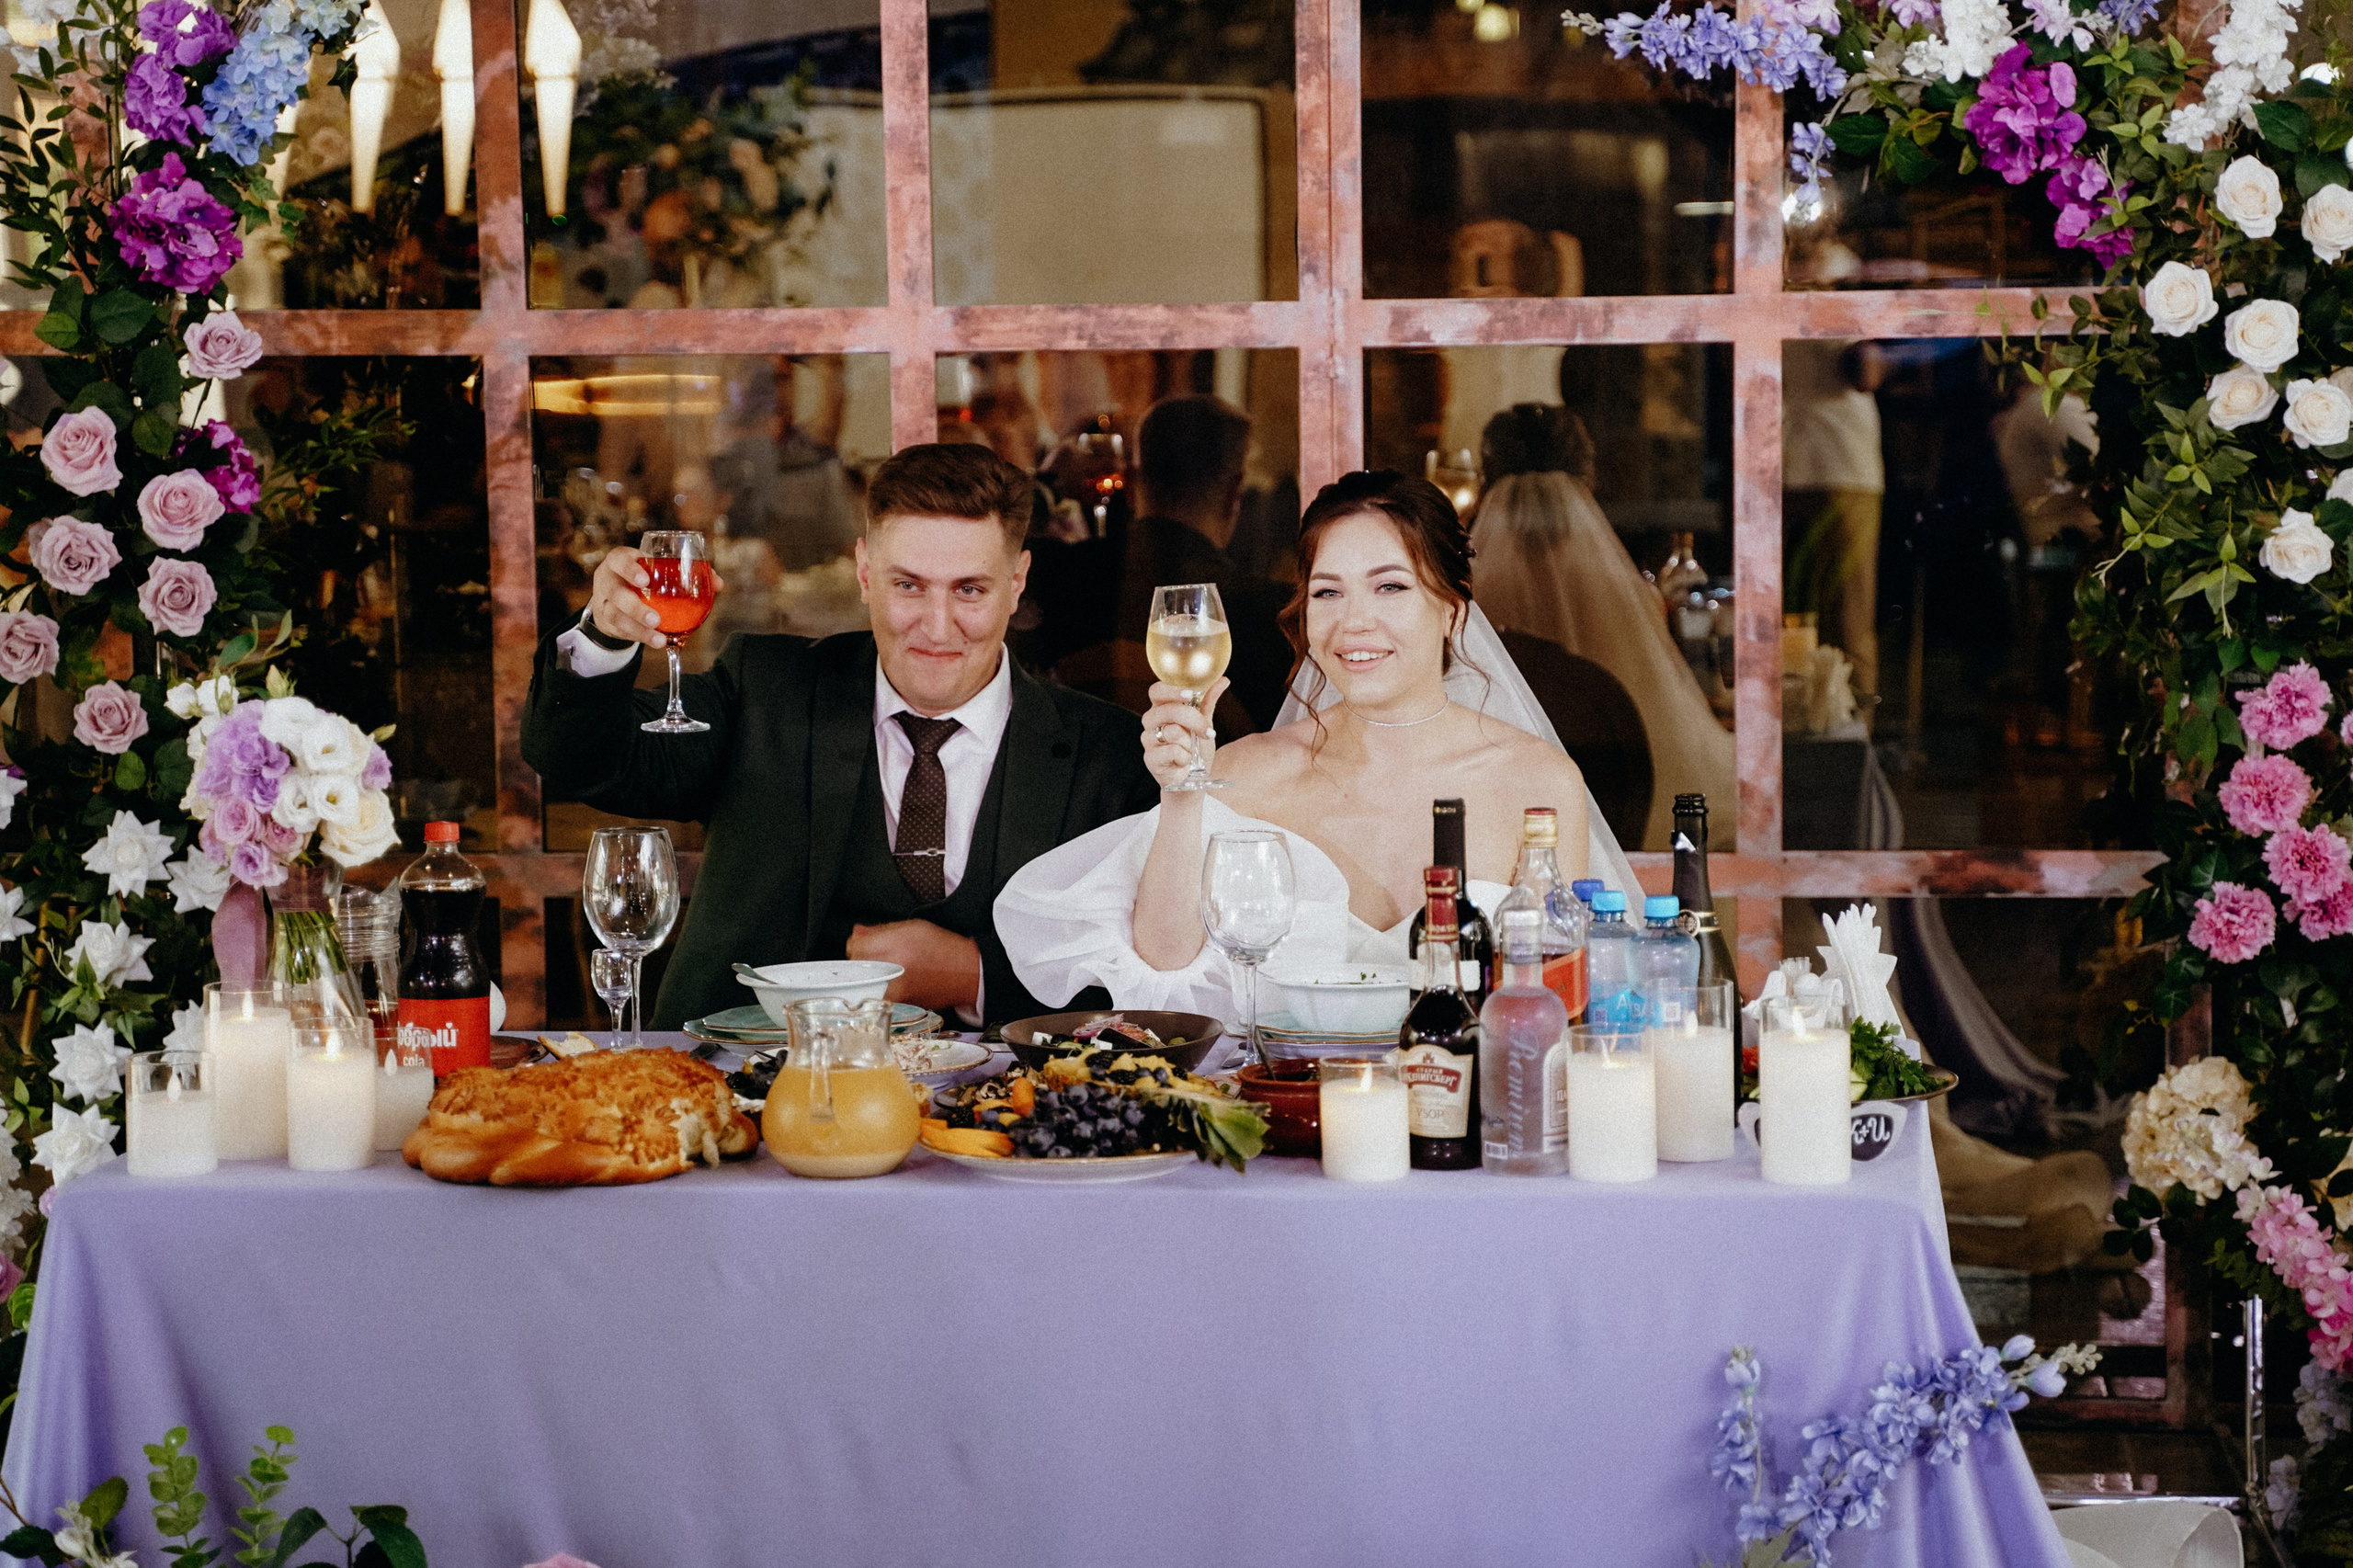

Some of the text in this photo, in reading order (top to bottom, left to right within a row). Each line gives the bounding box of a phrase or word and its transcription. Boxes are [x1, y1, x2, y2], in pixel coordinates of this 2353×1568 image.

[398, 1021, 458, 1051] обрый
[403, 1054, 426, 1067] cola
[1508, 1027, 1540, 1157] Premium
